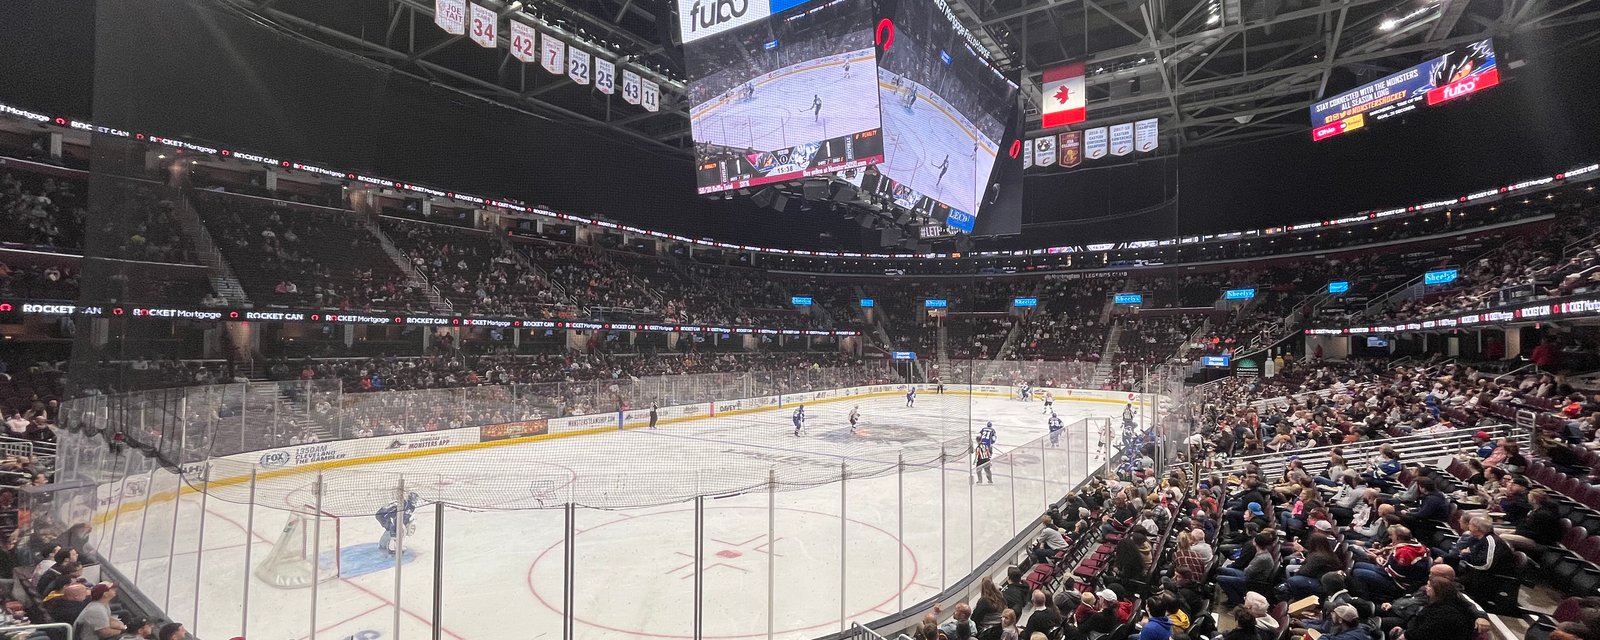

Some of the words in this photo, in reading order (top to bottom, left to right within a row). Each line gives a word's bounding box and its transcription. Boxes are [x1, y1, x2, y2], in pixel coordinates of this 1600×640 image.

[446, 10, 462, 23] TAIT
[447, 4, 462, 15] JOE
[690, 0, 749, 32] fubo
[945, 6, 967, 36] Mortgage
[474, 18, 494, 41] 34
[513, 35, 532, 56] 42
[549, 50, 556, 66] 7
[571, 60, 588, 79] 22
[598, 71, 613, 89] 25
[625, 82, 639, 99] 43
[1316, 102, 1329, 113] STAY
[1329, 89, 1359, 110] CONNECTED
[1360, 84, 1374, 97] WITH
[1374, 80, 1386, 92] THE
[1386, 69, 1419, 88] MONSTERS
[1444, 81, 1475, 99] fubo
[645, 91, 656, 107] 11
[1341, 101, 1351, 111] ALL
[1351, 94, 1373, 108] SEASON
[1374, 87, 1390, 100] LONG
[7, 106, 50, 123] Mortgage
[71, 120, 109, 134] ROCET
[111, 128, 129, 138] CAN
[150, 136, 184, 147] ROCKET
[184, 142, 217, 154] Mortgage
[826, 141, 831, 157] 1
[234, 151, 262, 162] ROCKET
[263, 157, 278, 165] CAN
[781, 155, 788, 164] 0
[294, 162, 319, 172] ROCKET
[319, 167, 346, 178] Mortgage
[736, 160, 741, 174] 1
[358, 175, 380, 184] ROCKET
[404, 184, 424, 192] ROCKET
[425, 188, 445, 196] Mortgage
[23, 304, 76, 314] ROCKET
[133, 308, 176, 316] ROCKET
[177, 310, 222, 319] Mortgage
[1562, 300, 1584, 313] ROCKET
[357, 316, 390, 324] Mortgage
[982, 431, 990, 439] 21
[409, 441, 437, 449] MONSTERS
[265, 453, 284, 462] FOX
[295, 450, 336, 460] CLEVELAND
